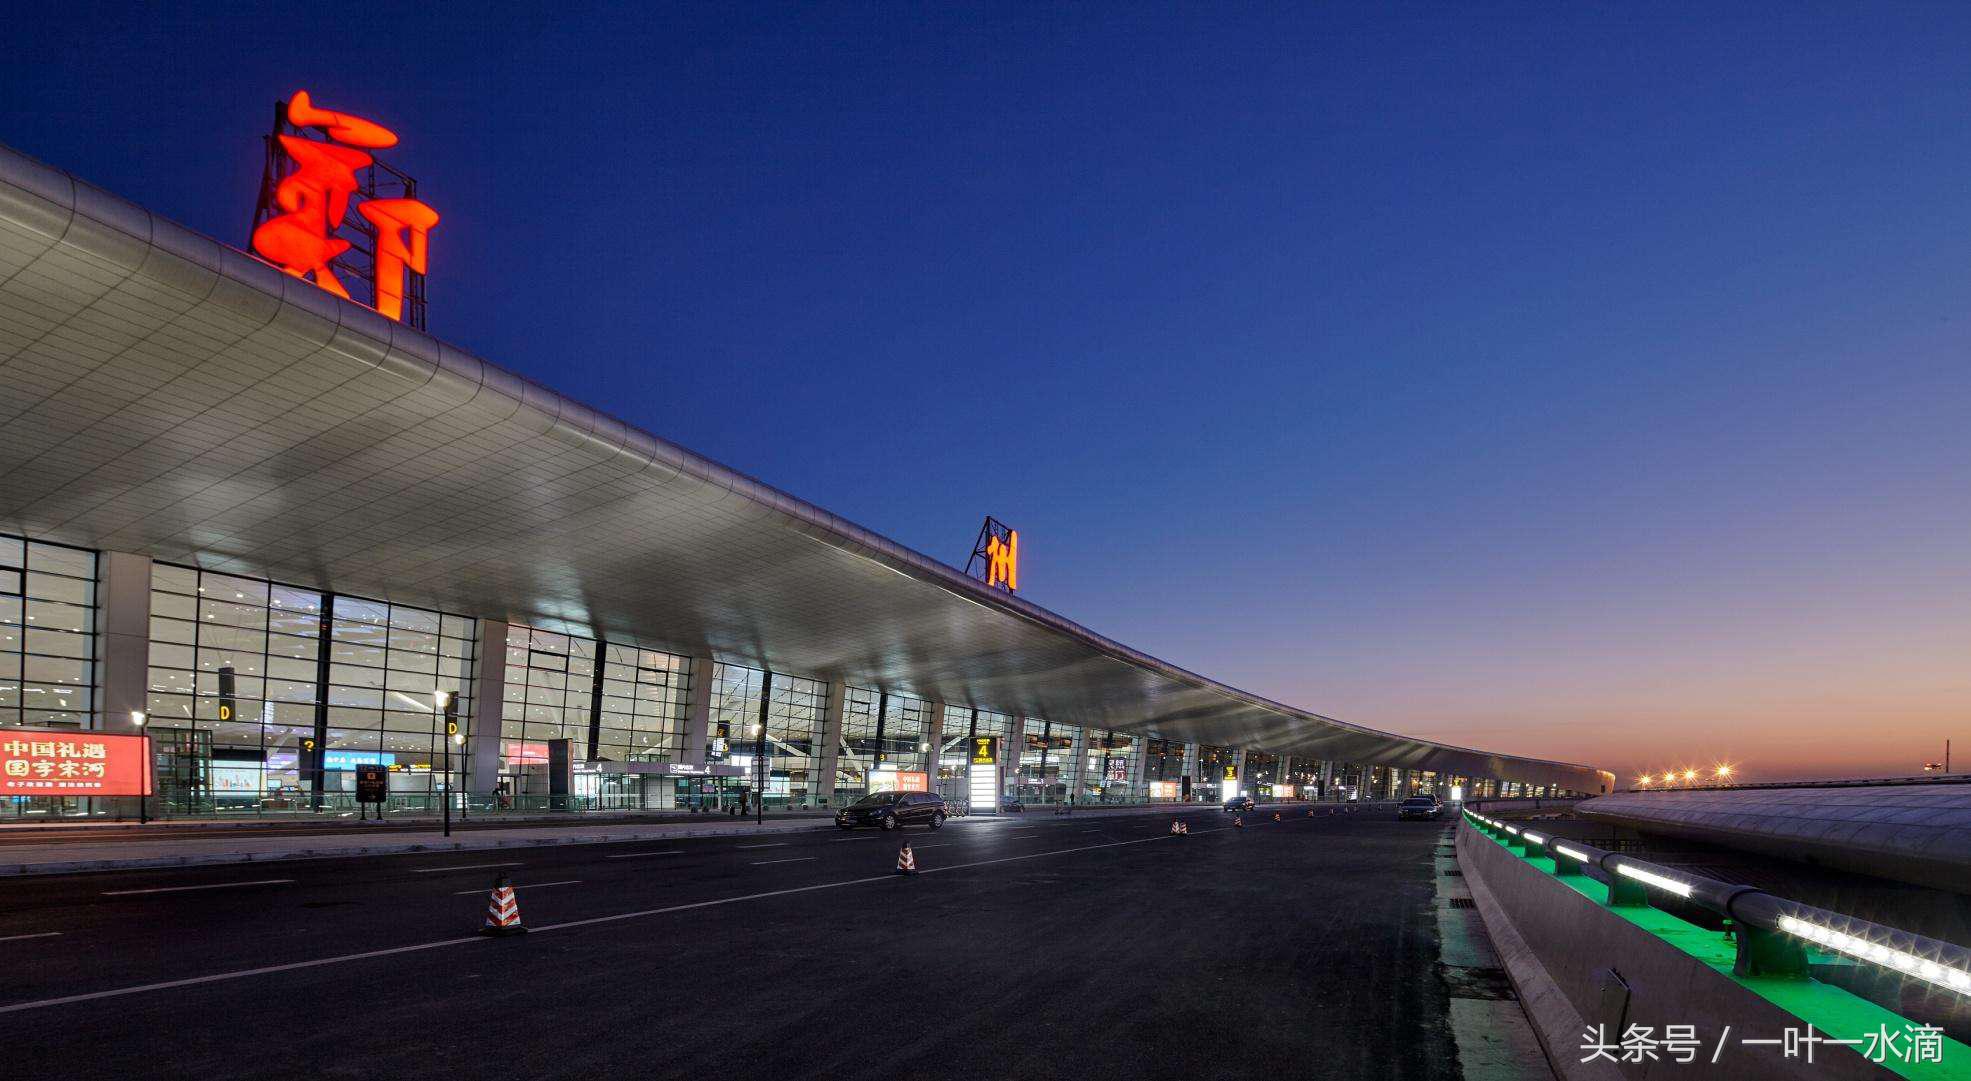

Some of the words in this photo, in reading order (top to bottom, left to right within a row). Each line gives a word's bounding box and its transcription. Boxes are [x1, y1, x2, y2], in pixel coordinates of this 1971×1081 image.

[987, 530, 1018, 590] 州
[220, 705, 230, 720] D
[448, 722, 458, 734] D
[3, 740, 107, 759] 中国礼遇
[979, 745, 988, 757] 4
